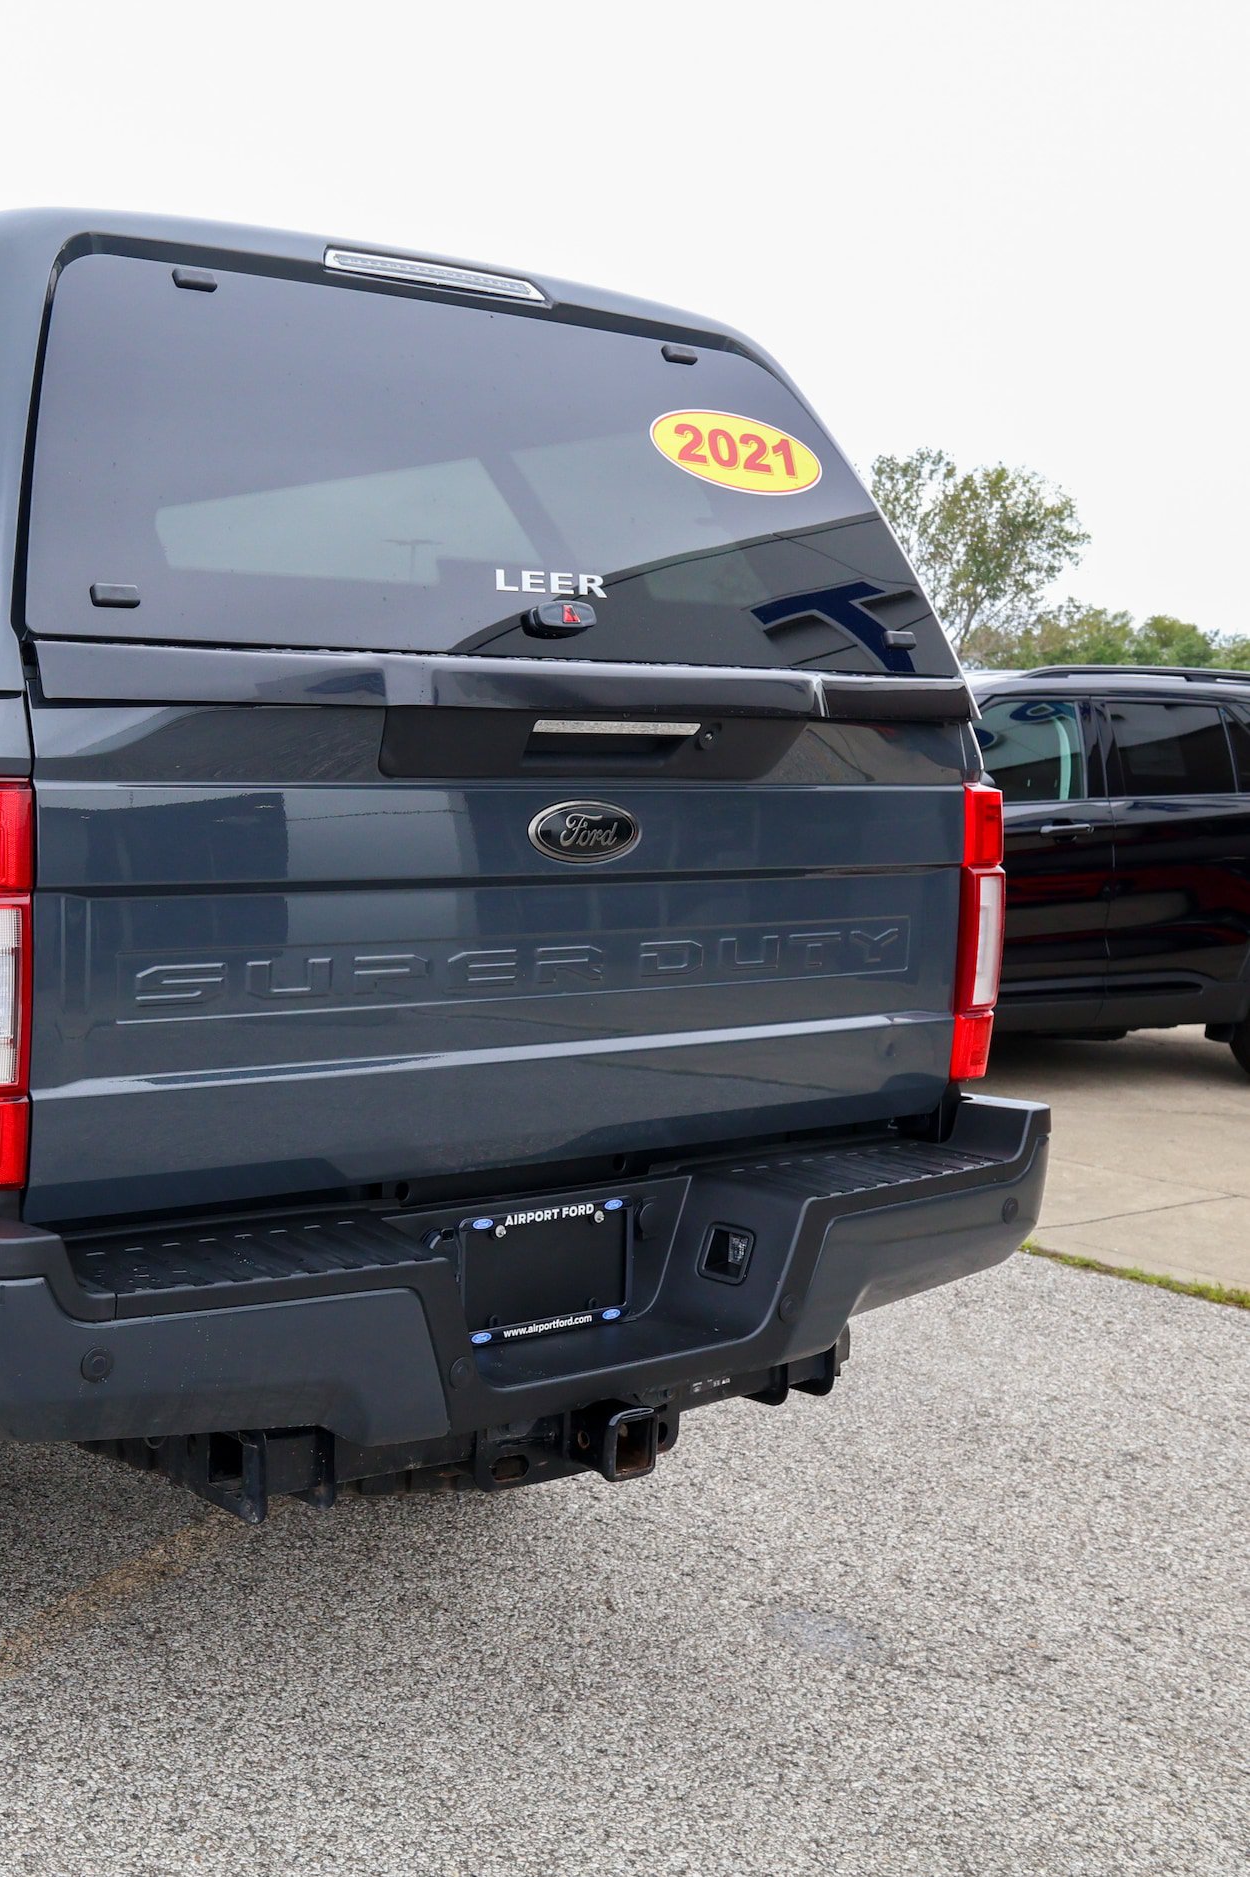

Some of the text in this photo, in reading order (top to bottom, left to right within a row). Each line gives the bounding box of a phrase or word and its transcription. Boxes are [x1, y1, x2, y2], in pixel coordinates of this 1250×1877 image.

[673, 423, 798, 479] 2021
[495, 568, 608, 599] LEER
[559, 813, 618, 847] Ford
[135, 927, 900, 1008] SUPER DUTY
[504, 1203, 595, 1227] AIRPORT FORD
[503, 1315, 593, 1338] www.airportford.com
